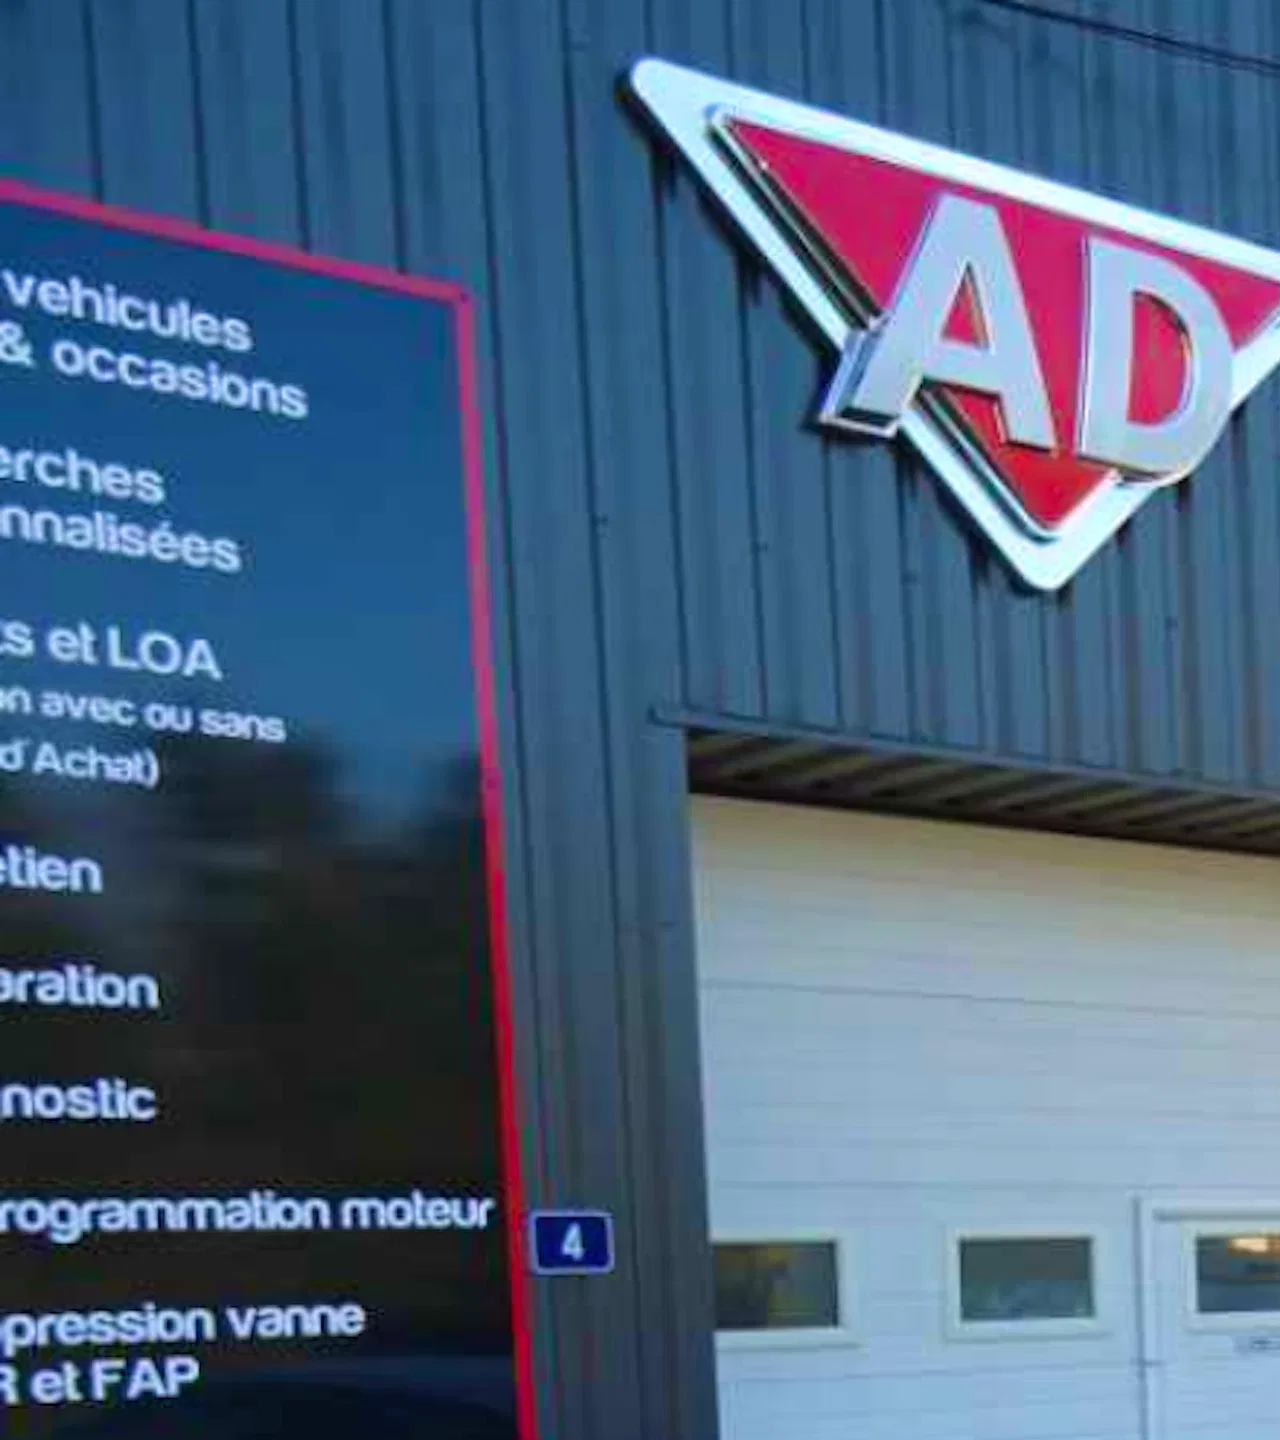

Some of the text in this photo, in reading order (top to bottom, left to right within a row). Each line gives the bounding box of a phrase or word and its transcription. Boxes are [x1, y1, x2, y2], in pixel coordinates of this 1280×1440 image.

[2, 267, 253, 352] vehicules
[822, 192, 1236, 486] AD
[0, 320, 310, 420] & occasions
[46, 621, 98, 666] et
[107, 625, 223, 682] LOA
[40, 690, 138, 728] avec
[142, 702, 195, 733] ou
[200, 706, 288, 744] sans
[0, 843, 103, 893] tien
[1, 1078, 157, 1120] nostic
[341, 1190, 495, 1230] moteur
[561, 1223, 585, 1261] 4
[226, 1302, 365, 1339] vanne
[31, 1361, 82, 1404] et
[91, 1357, 200, 1398] FAP
